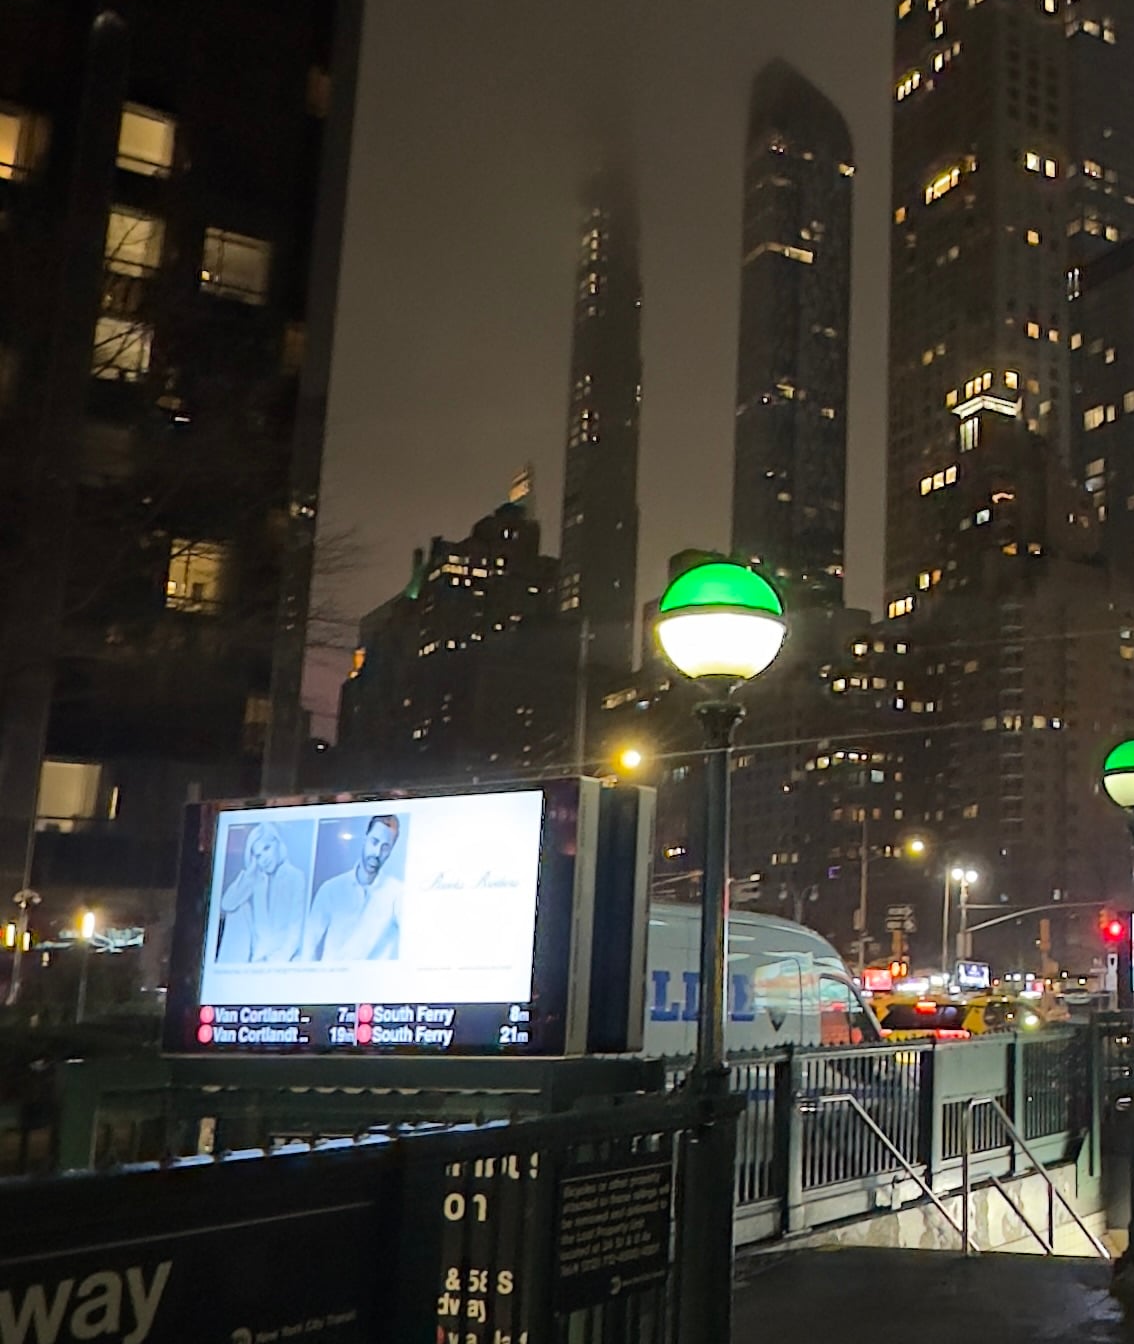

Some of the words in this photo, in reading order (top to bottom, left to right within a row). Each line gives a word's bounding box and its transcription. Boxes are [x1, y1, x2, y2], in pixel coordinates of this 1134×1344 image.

[215, 1006, 238, 1024] Van
[240, 1006, 300, 1024] Cortlandt
[374, 1007, 414, 1023] South
[416, 1006, 455, 1026] Ferry
[213, 1026, 236, 1043] Van
[238, 1026, 299, 1043] Cortlandt
[372, 1026, 412, 1043] South
[414, 1025, 454, 1046] Ferry
